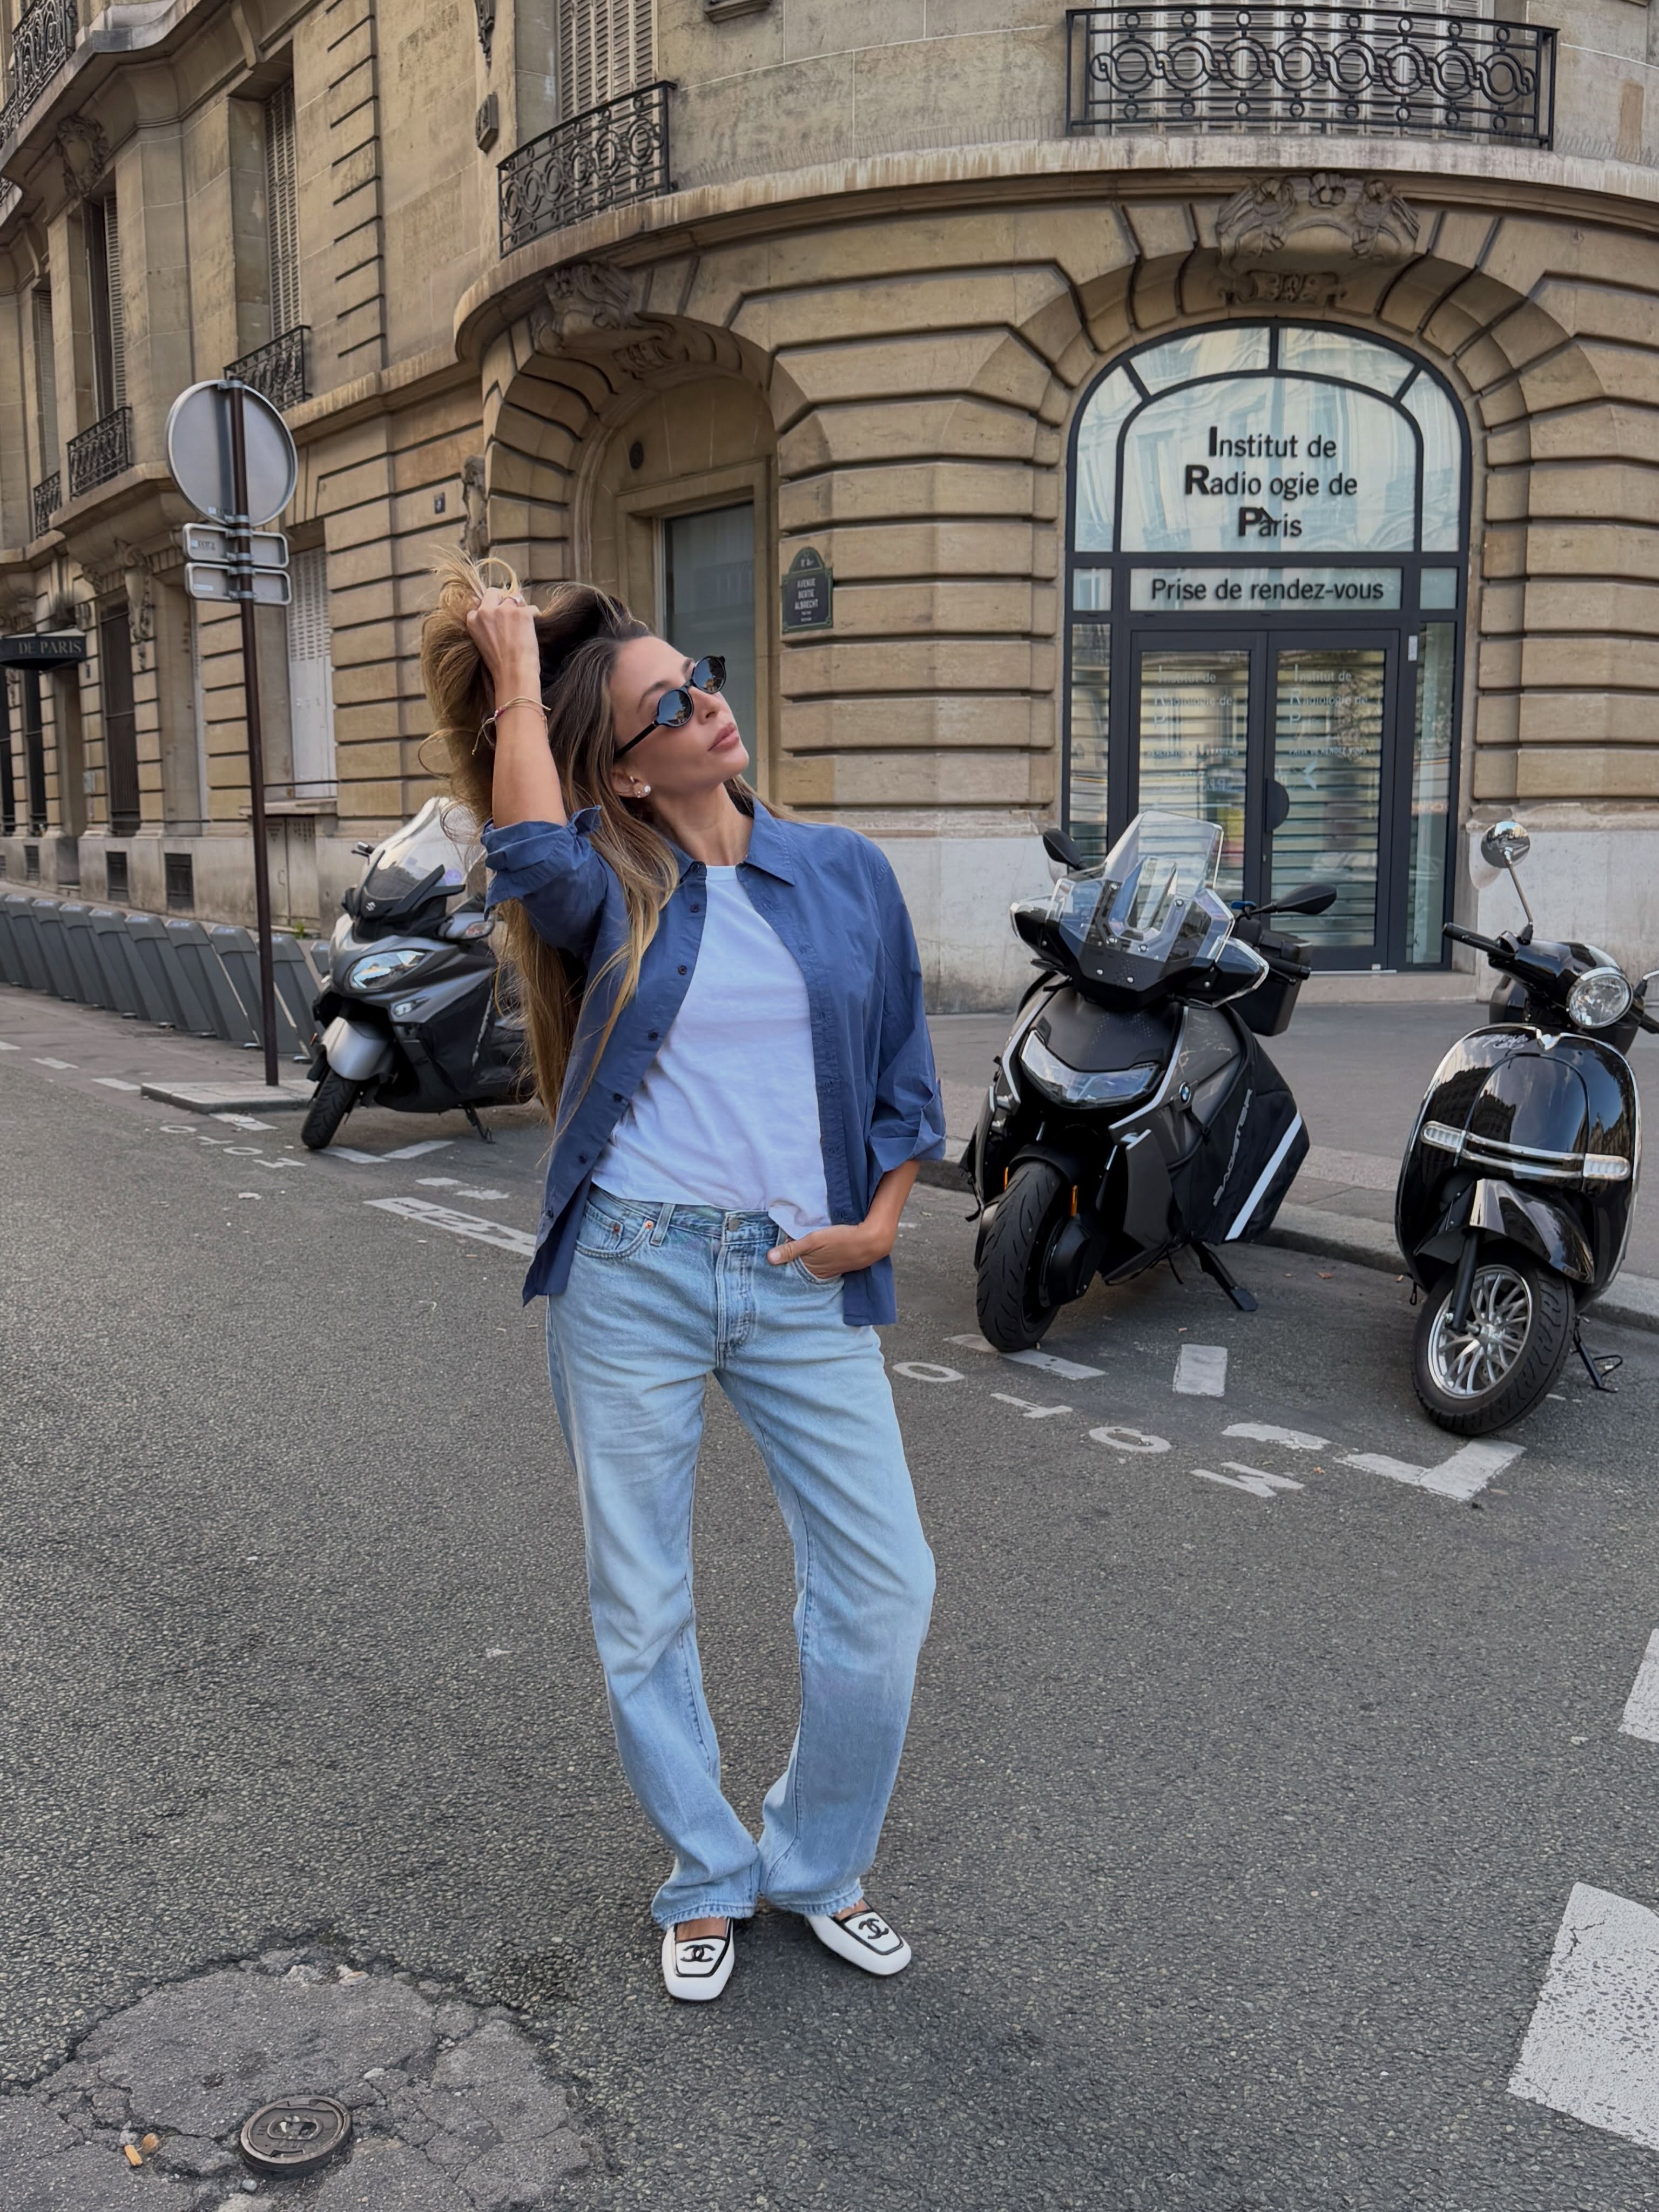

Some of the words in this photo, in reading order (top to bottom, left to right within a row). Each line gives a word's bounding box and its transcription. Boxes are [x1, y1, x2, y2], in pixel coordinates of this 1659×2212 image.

[1208, 426, 1298, 457] Institut
[1307, 434, 1337, 457] de
[1328, 472, 1358, 496] de
[1238, 507, 1303, 538] Paris
[1151, 578, 1207, 601] Prise
[1216, 578, 1242, 601] de
[1251, 578, 1384, 601] rendez-vous
[19, 642, 35, 655] DE
[41, 640, 81, 654] PARIS
[1294, 664, 1335, 682] Institut
[1338, 671, 1352, 682] de
